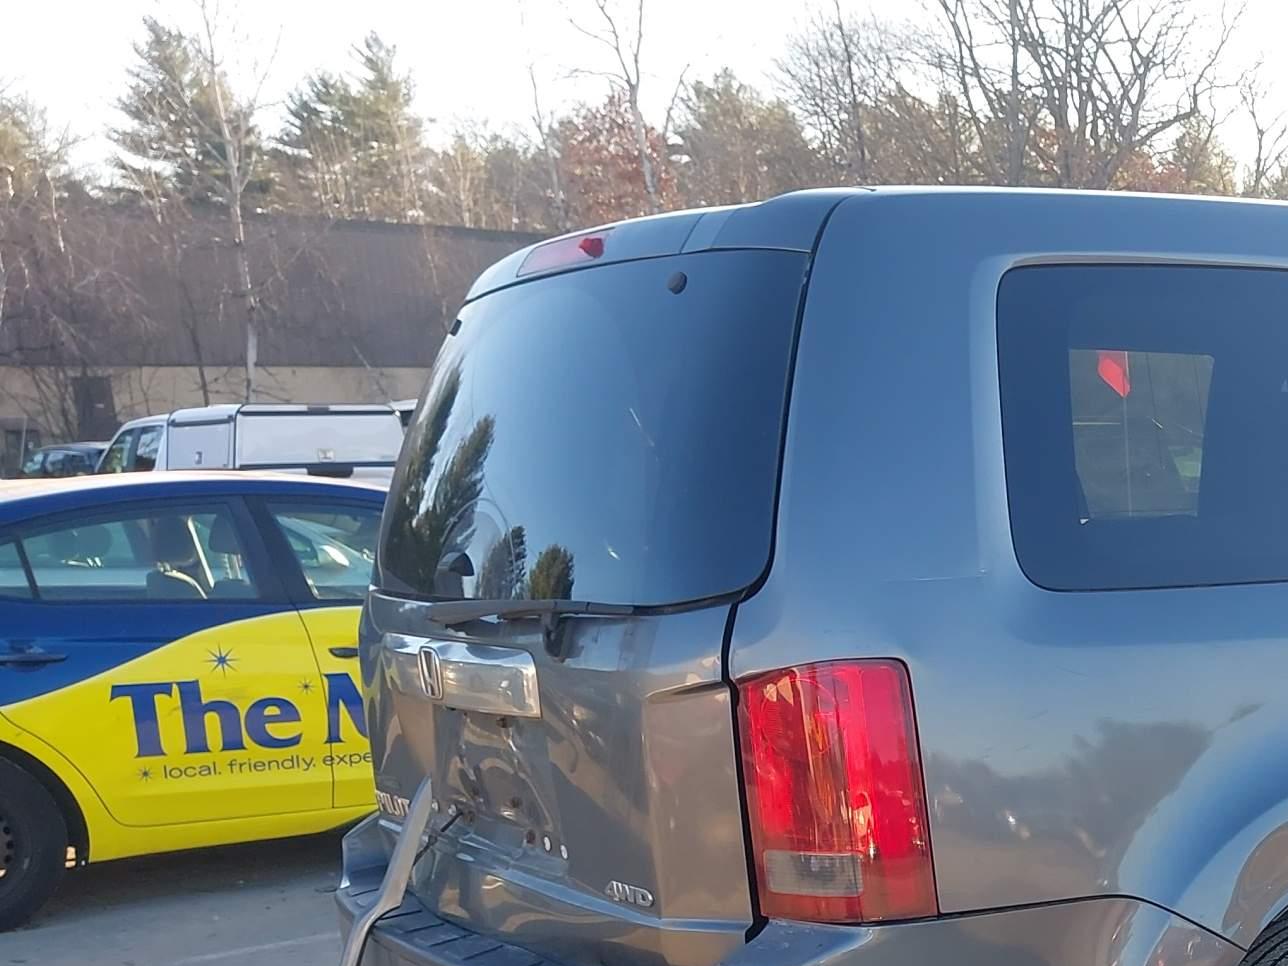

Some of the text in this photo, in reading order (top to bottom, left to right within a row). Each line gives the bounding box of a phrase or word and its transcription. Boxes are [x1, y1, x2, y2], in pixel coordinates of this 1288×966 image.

[109, 680, 302, 758] The
[163, 761, 221, 779] local.
[227, 755, 316, 774] friendly.
[606, 880, 654, 906] 4WD
